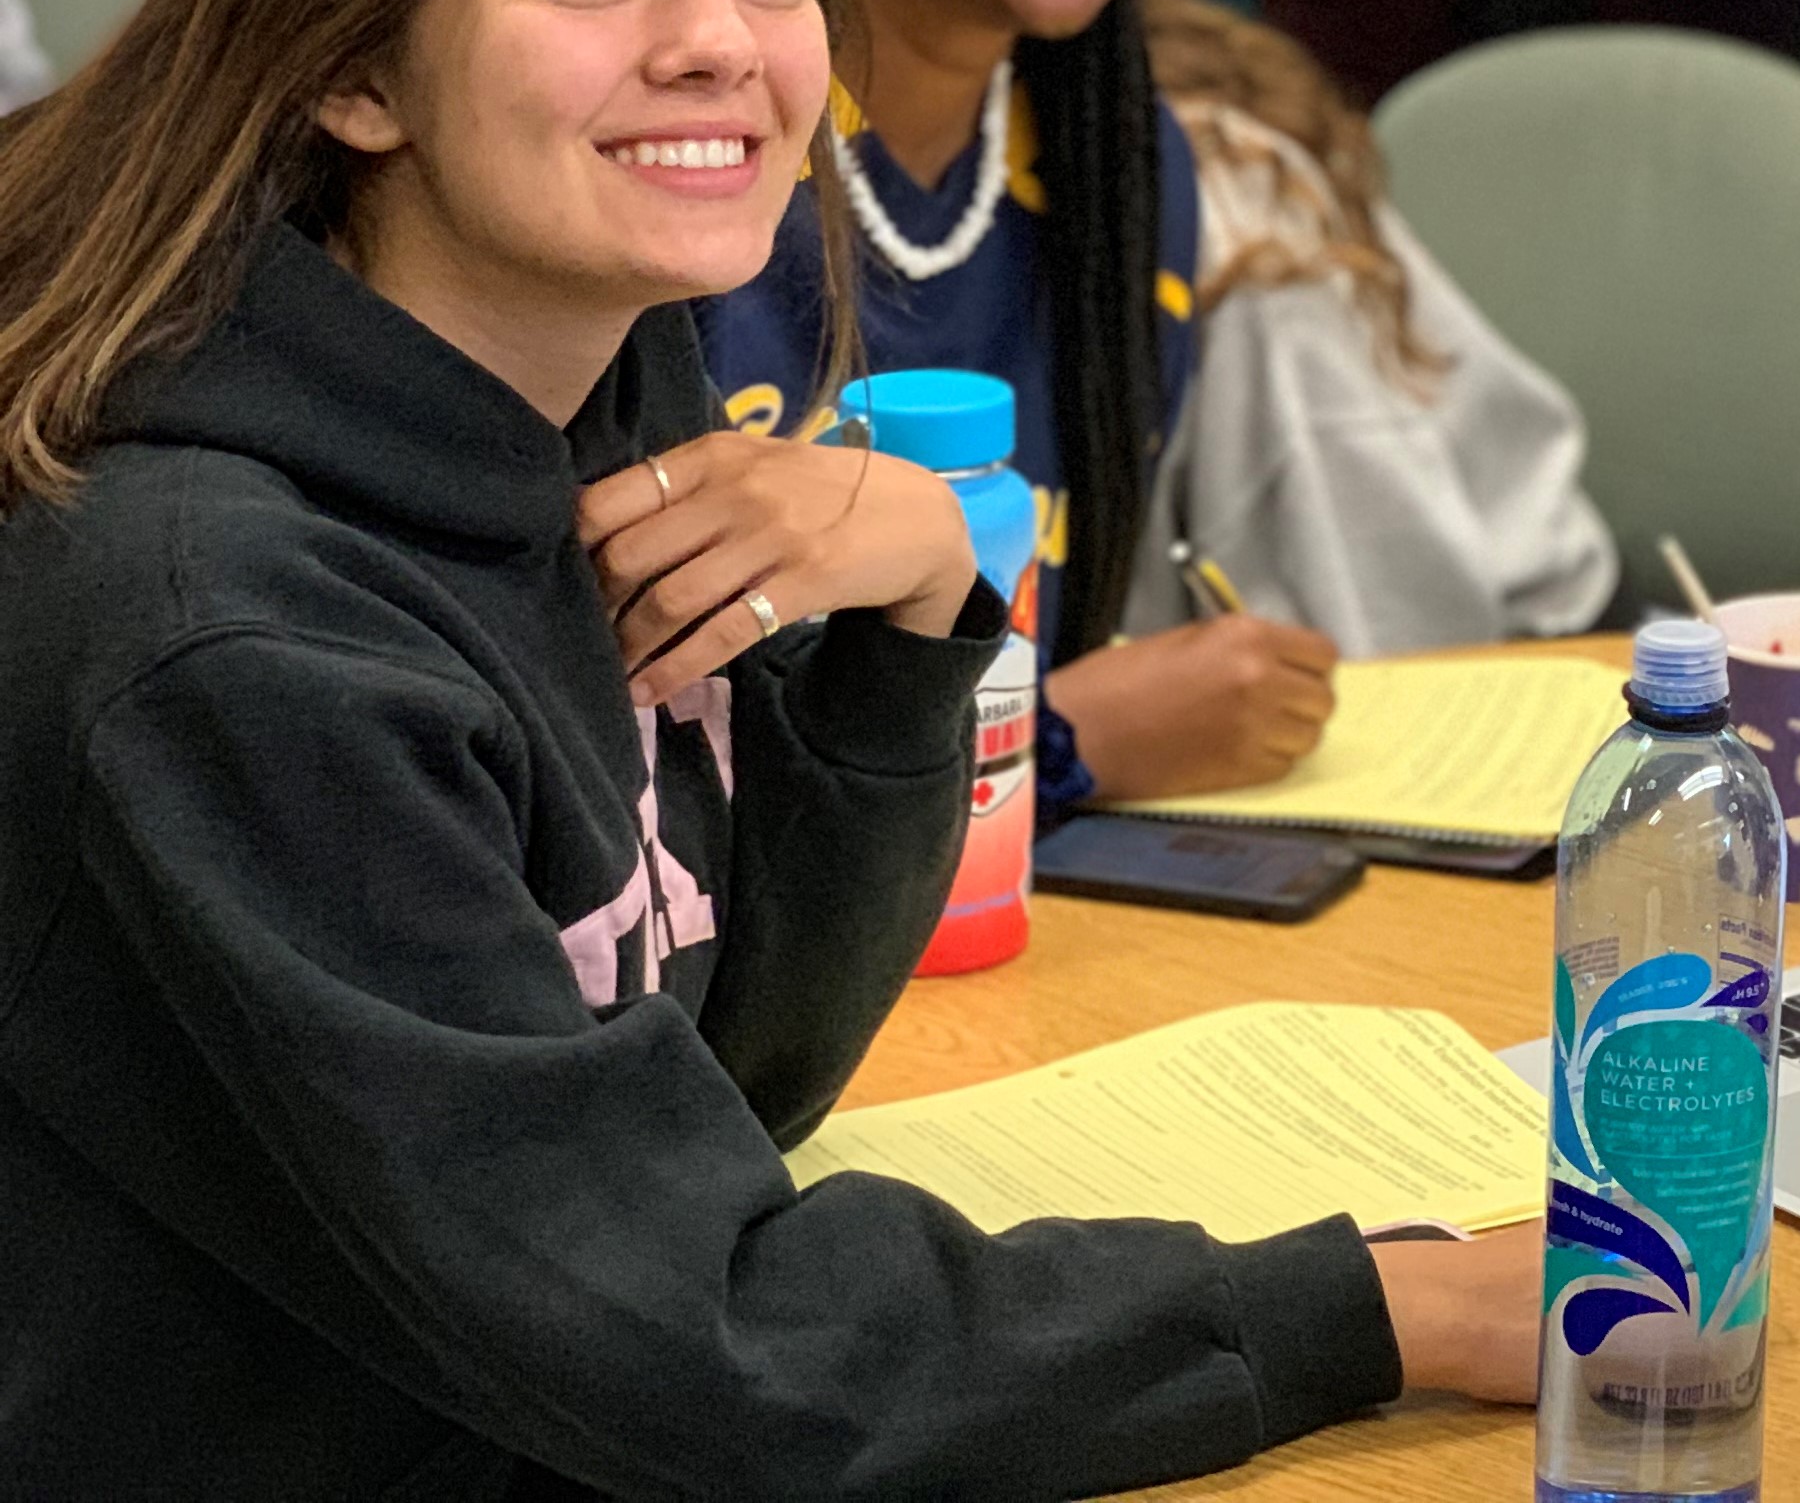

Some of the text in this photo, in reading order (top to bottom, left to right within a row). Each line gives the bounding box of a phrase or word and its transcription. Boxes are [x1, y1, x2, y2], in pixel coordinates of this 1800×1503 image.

[1603, 1050, 1709, 1073] ALKALINE
[1602, 1071, 1694, 1092] WATER +
[1601, 1087, 1755, 1112] ELECTROLYTES
[1580, 1210, 1624, 1236] hydrate
